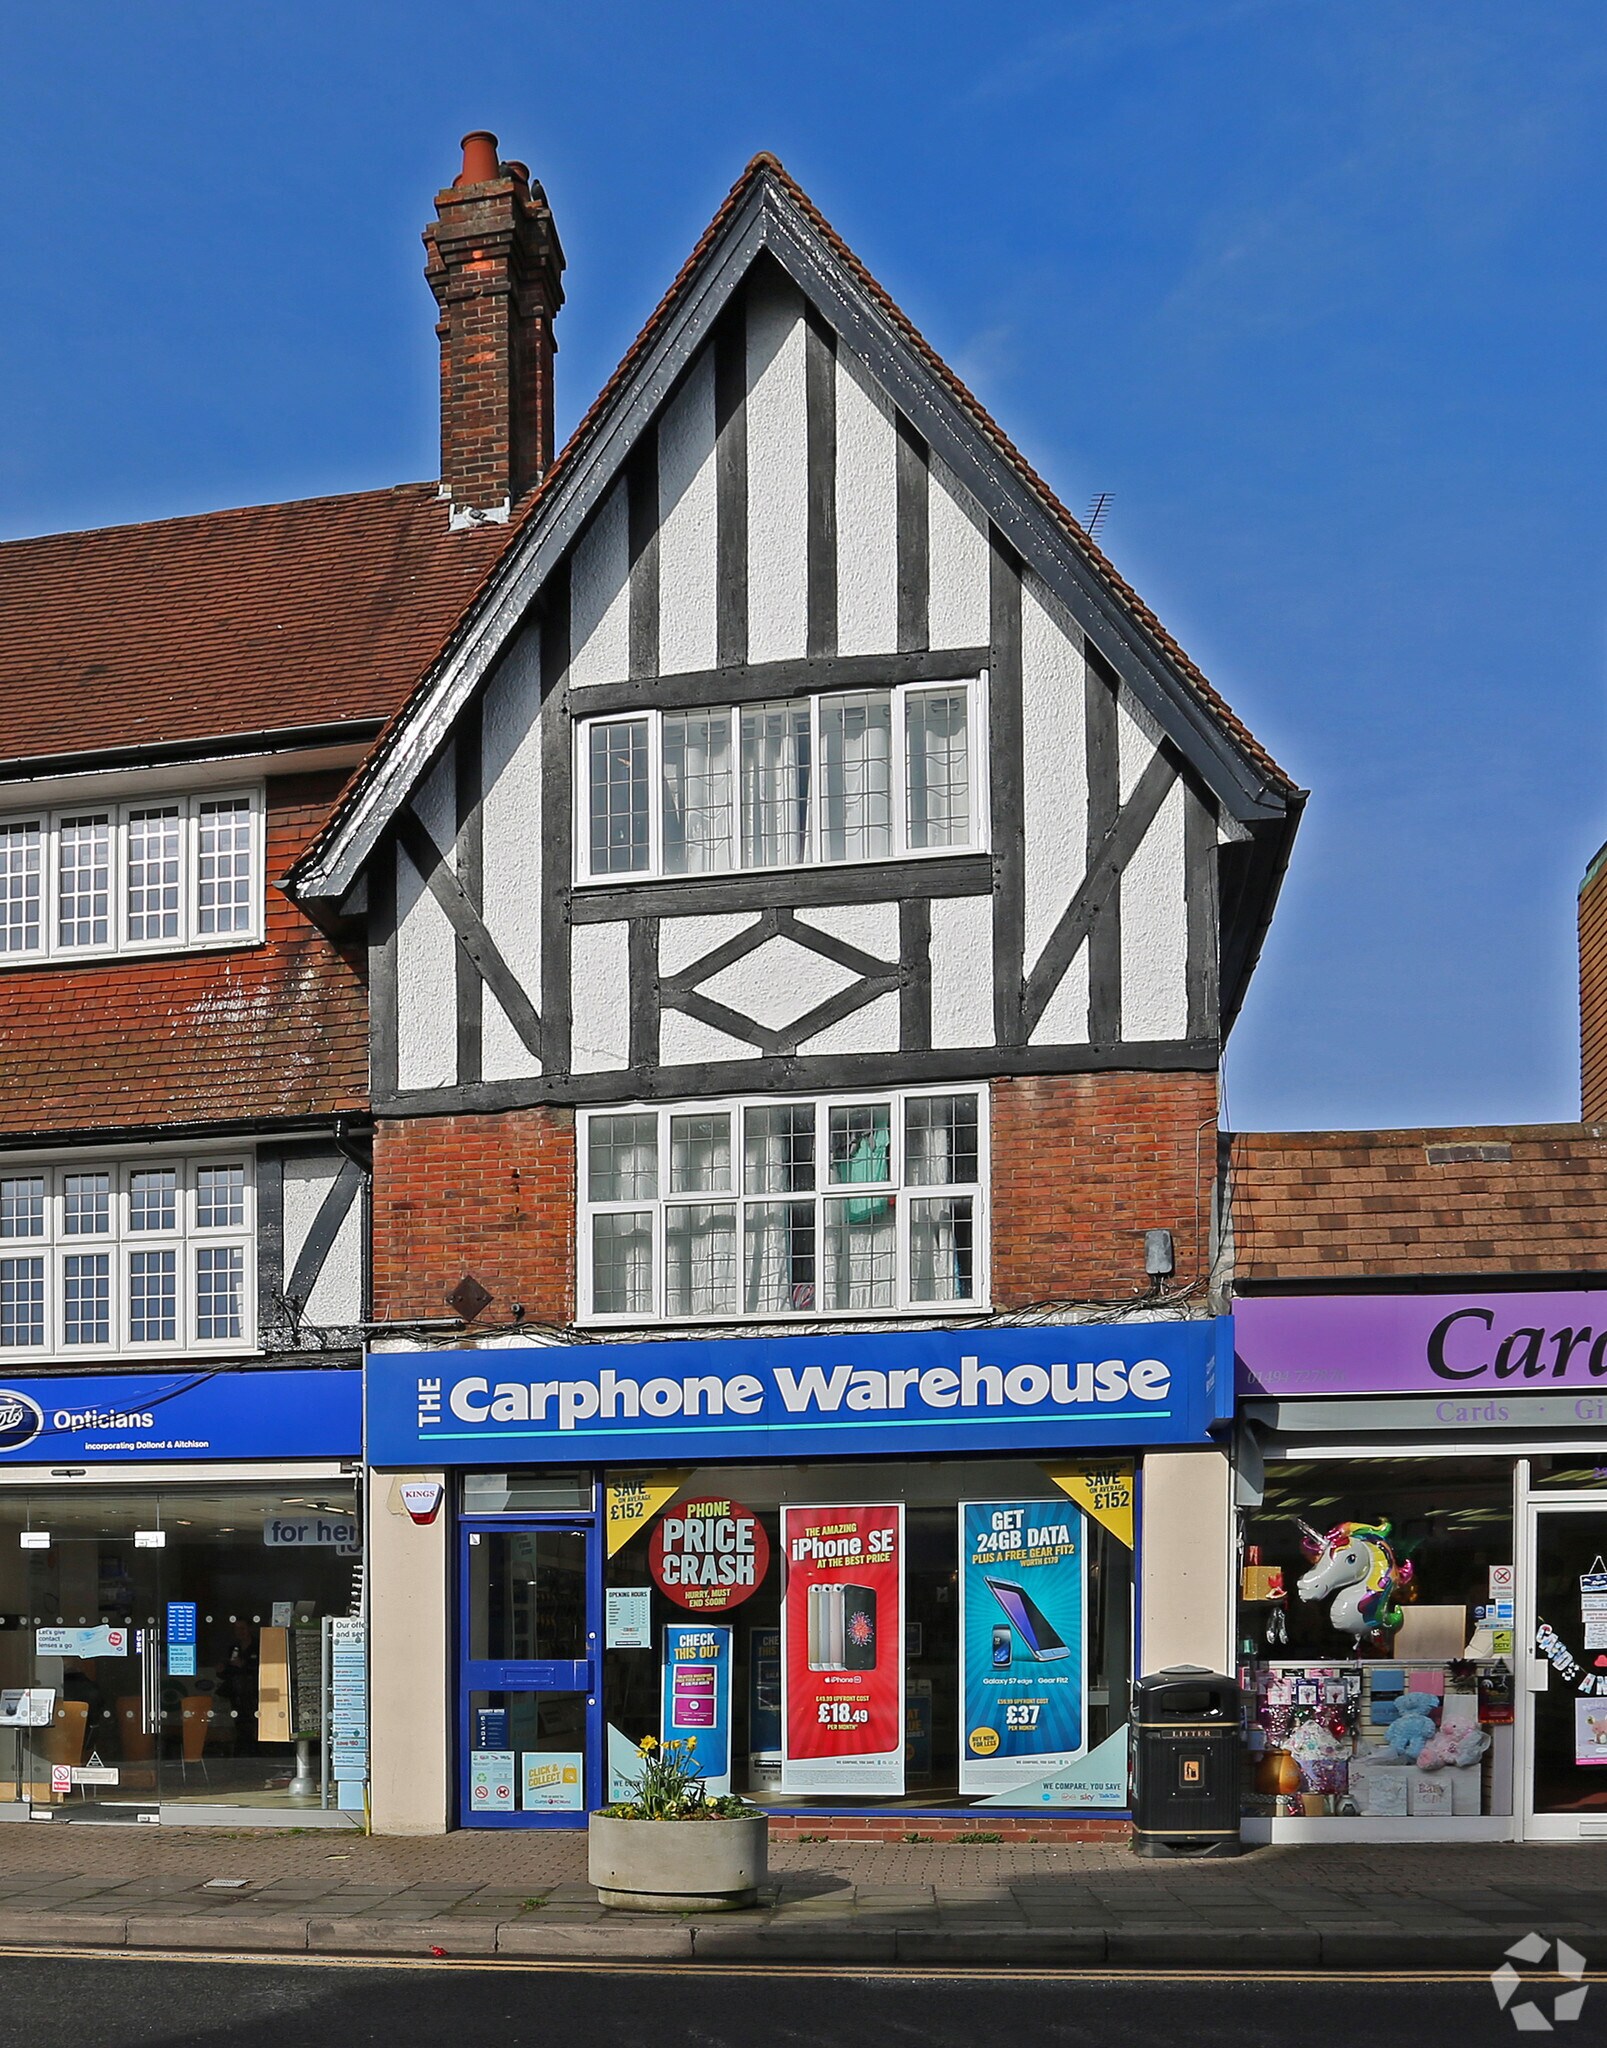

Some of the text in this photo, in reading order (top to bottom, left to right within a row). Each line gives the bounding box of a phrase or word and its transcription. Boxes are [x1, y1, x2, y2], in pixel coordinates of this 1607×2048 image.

[418, 1377, 441, 1428] THE
[449, 1369, 764, 1430] Carphone
[772, 1356, 1171, 1412] Warehouse
[1436, 1400, 1509, 1422] Cards
[53, 1409, 154, 1432] Opticians
[136, 1441, 165, 1450] Dollond
[166, 1441, 173, 1449] &
[174, 1441, 209, 1449] Aitchison
[1085, 1471, 1121, 1487] SAVE
[613, 1480, 646, 1497] SAVE
[1099, 1484, 1125, 1493] AVERAGE
[1094, 1490, 1130, 1509] £152
[610, 1502, 644, 1520] £152
[687, 1500, 731, 1518] PHONE
[991, 1508, 1025, 1531] GET
[271, 1520, 309, 1542] for
[663, 1518, 755, 1553] PRICE
[805, 1522, 857, 1537] THE AMAZING
[792, 1528, 894, 1561] iPhone SE
[977, 1524, 1070, 1552] 24GB DATA
[816, 1552, 891, 1569] AT THE BEST PRICE
[972, 1544, 1075, 1565] PLUS A FREE GEAR FIT2
[1020, 1558, 1043, 1567] WORTH
[662, 1554, 755, 1585] CRASH
[685, 1589, 731, 1600] HURRY, MUST
[689, 1597, 726, 1608] END SOON!
[54, 1629, 66, 1637] give
[679, 1633, 715, 1648] CHECK
[38, 1642, 58, 1650] lenses
[674, 1645, 721, 1660] THIS OUT
[831, 1675, 854, 1684] iPhone
[983, 1677, 1008, 1686] Galaxy
[1017, 1678, 1034, 1686] edge
[1038, 1676, 1055, 1684] Gear
[817, 1702, 869, 1723] £18.49
[1006, 1704, 1040, 1724] £37
[528, 1763, 559, 1778] CLICK &
[528, 1772, 561, 1787] COLLECT
[1055, 1782, 1089, 1791] COMPARE,
[1090, 1782, 1104, 1790] YOU
[1105, 1782, 1121, 1790] SAVE
[1080, 1793, 1095, 1801] sky
